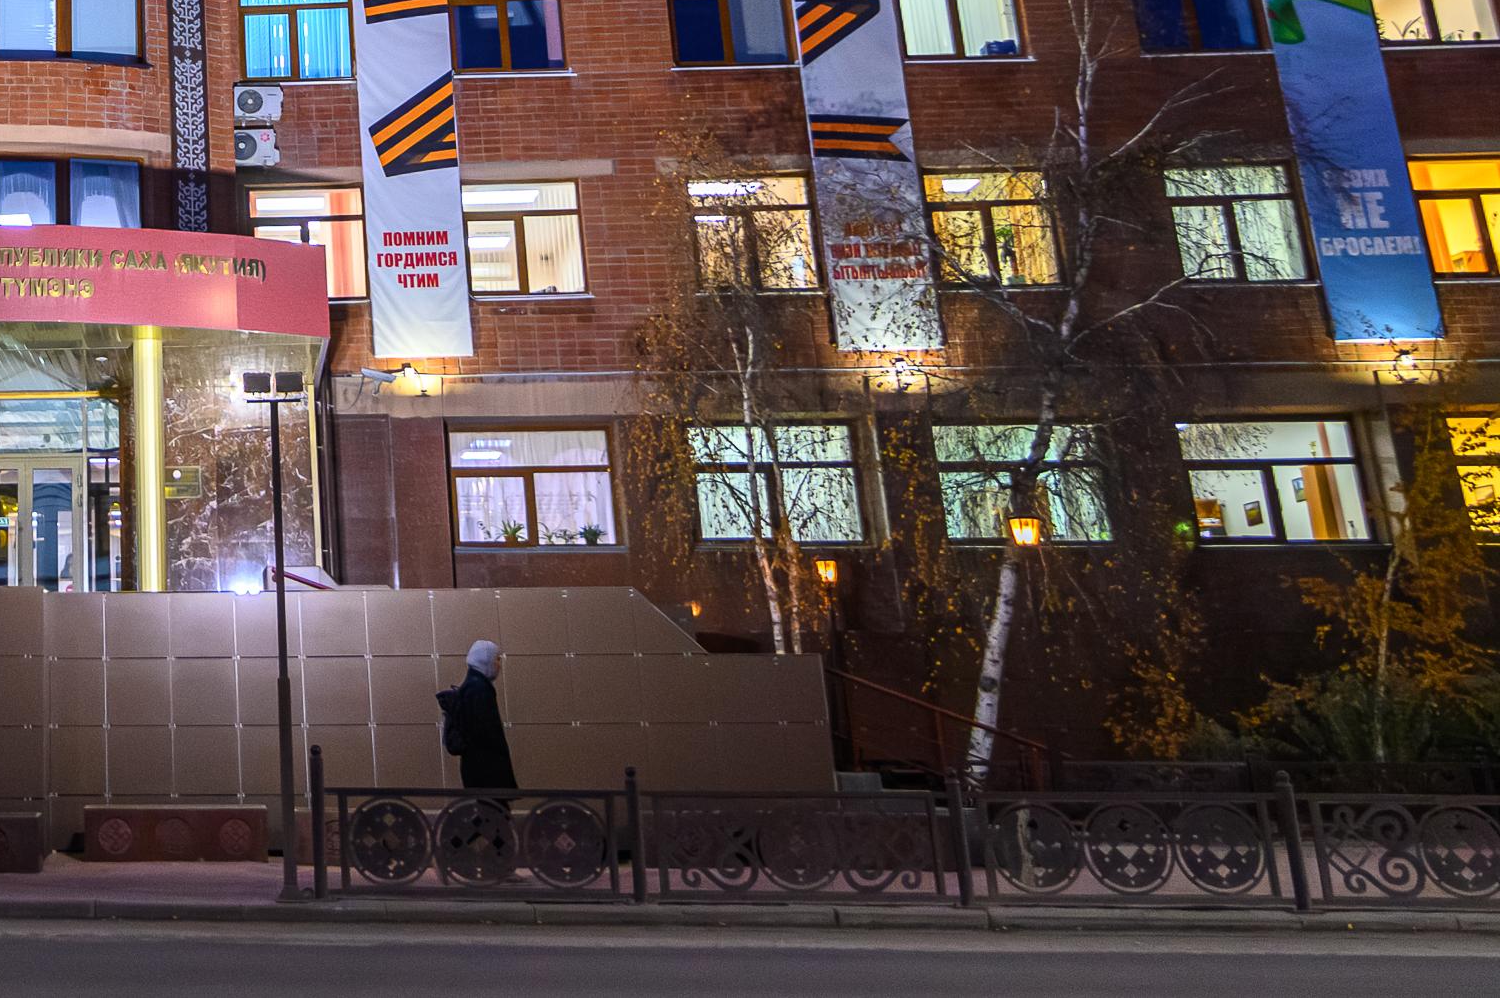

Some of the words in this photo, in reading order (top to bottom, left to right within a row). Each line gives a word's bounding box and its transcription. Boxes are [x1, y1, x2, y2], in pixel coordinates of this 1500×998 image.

[383, 230, 449, 247] ПОМНИМ
[110, 249, 168, 271] САХА
[174, 253, 267, 283] (ЯКУТИЯ)
[376, 251, 458, 269] ГОРДИМСЯ
[0, 277, 95, 299] ТҮМЭНЭ
[397, 273, 440, 289] ЧТИМ
